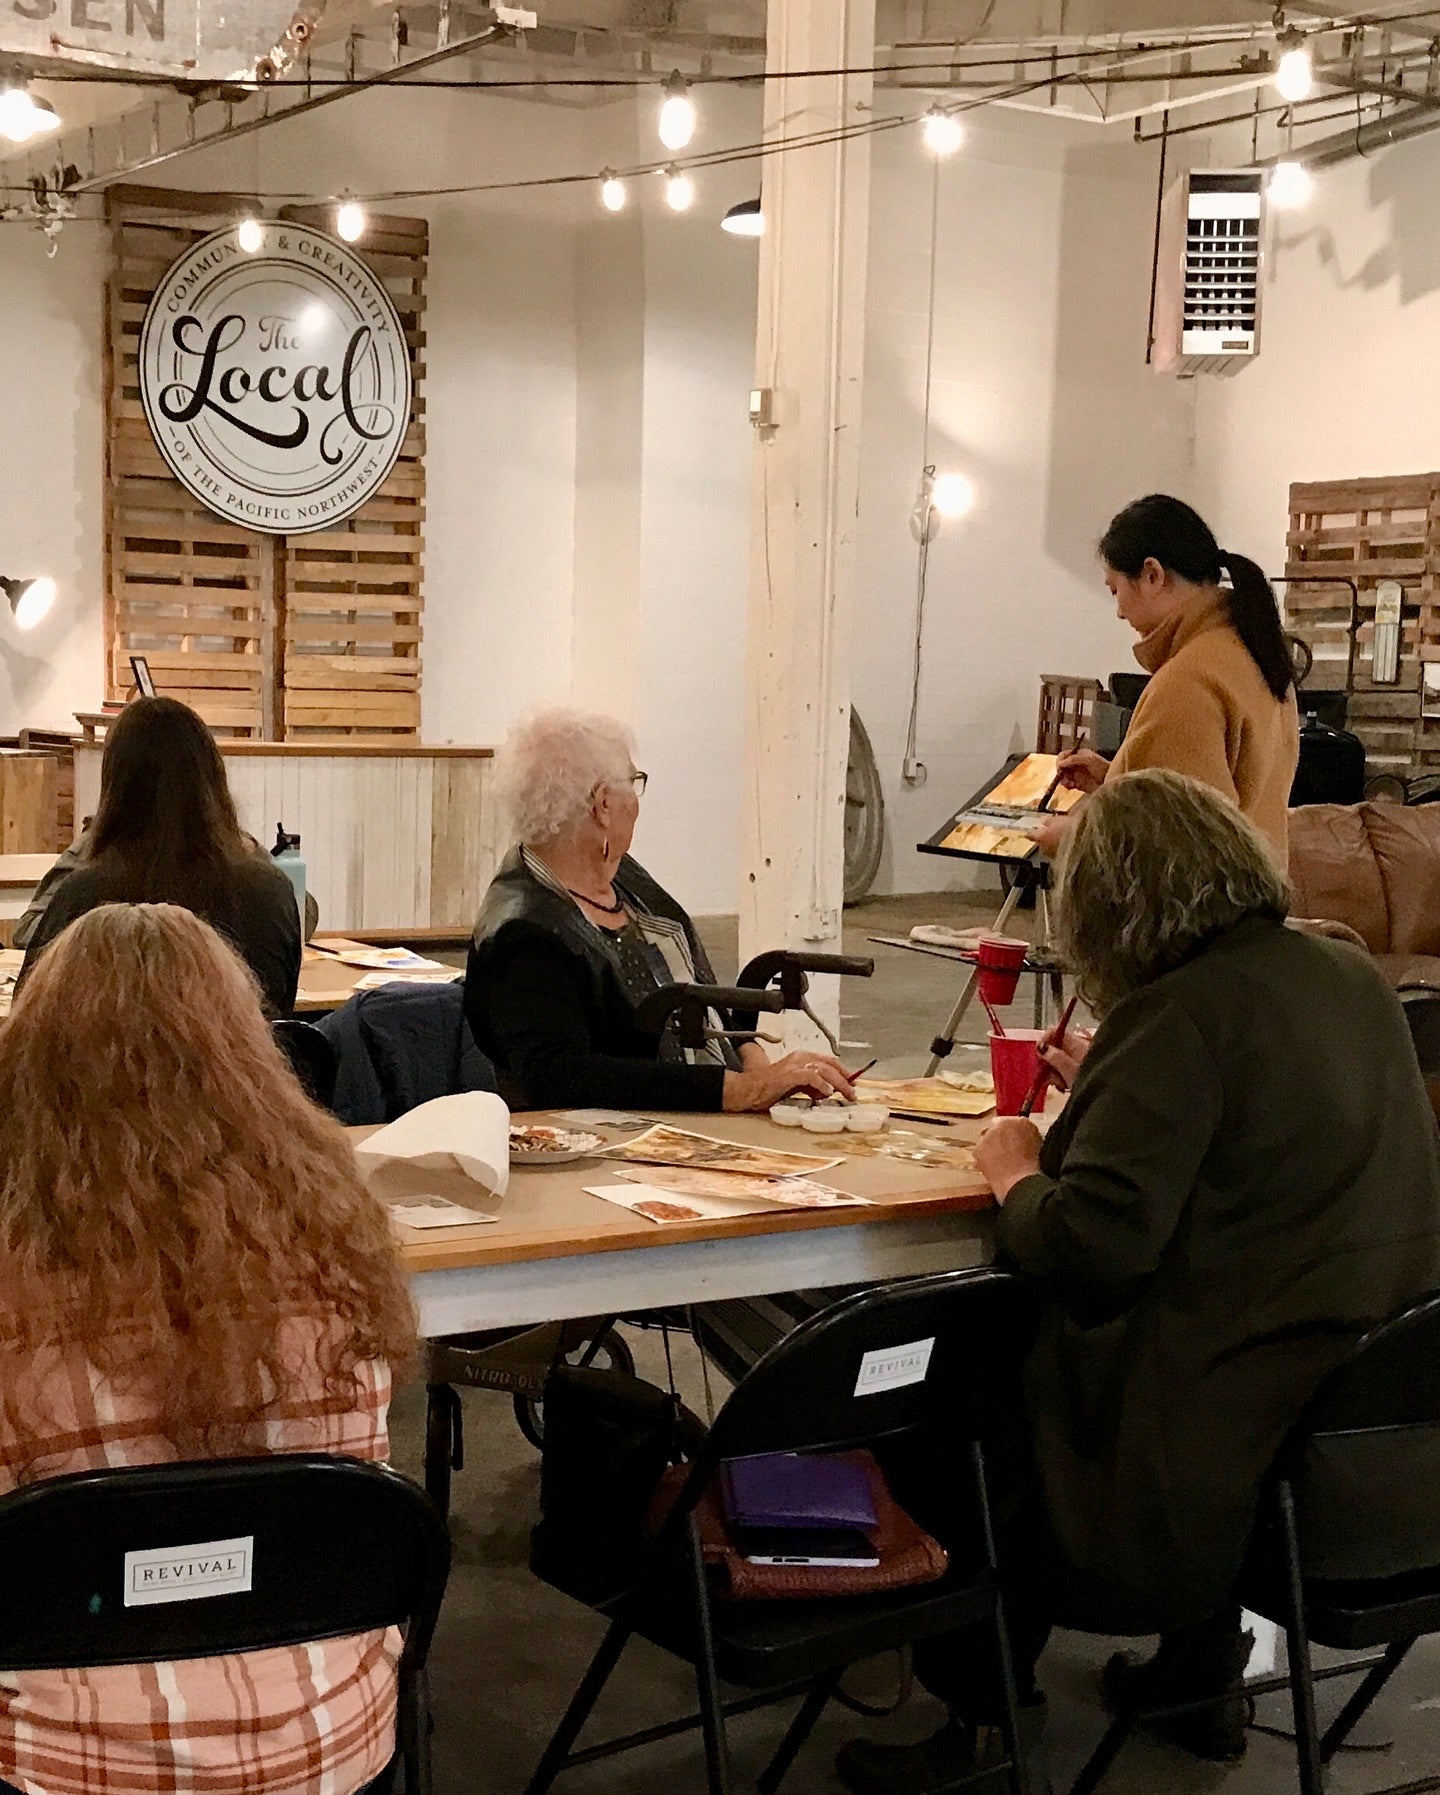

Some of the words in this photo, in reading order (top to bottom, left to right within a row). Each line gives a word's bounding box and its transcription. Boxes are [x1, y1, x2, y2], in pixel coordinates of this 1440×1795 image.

[278, 235, 290, 250] &
[299, 239, 390, 333] CREATIVITY
[158, 314, 395, 465] Local
[173, 439, 193, 462] OF
[193, 464, 222, 497] THE
[226, 491, 291, 520] PACIFIC
[297, 458, 380, 519] NORTHWEST
[868, 1355, 922, 1375] REVIVAL
[143, 1558, 237, 1581] REVIVAL
